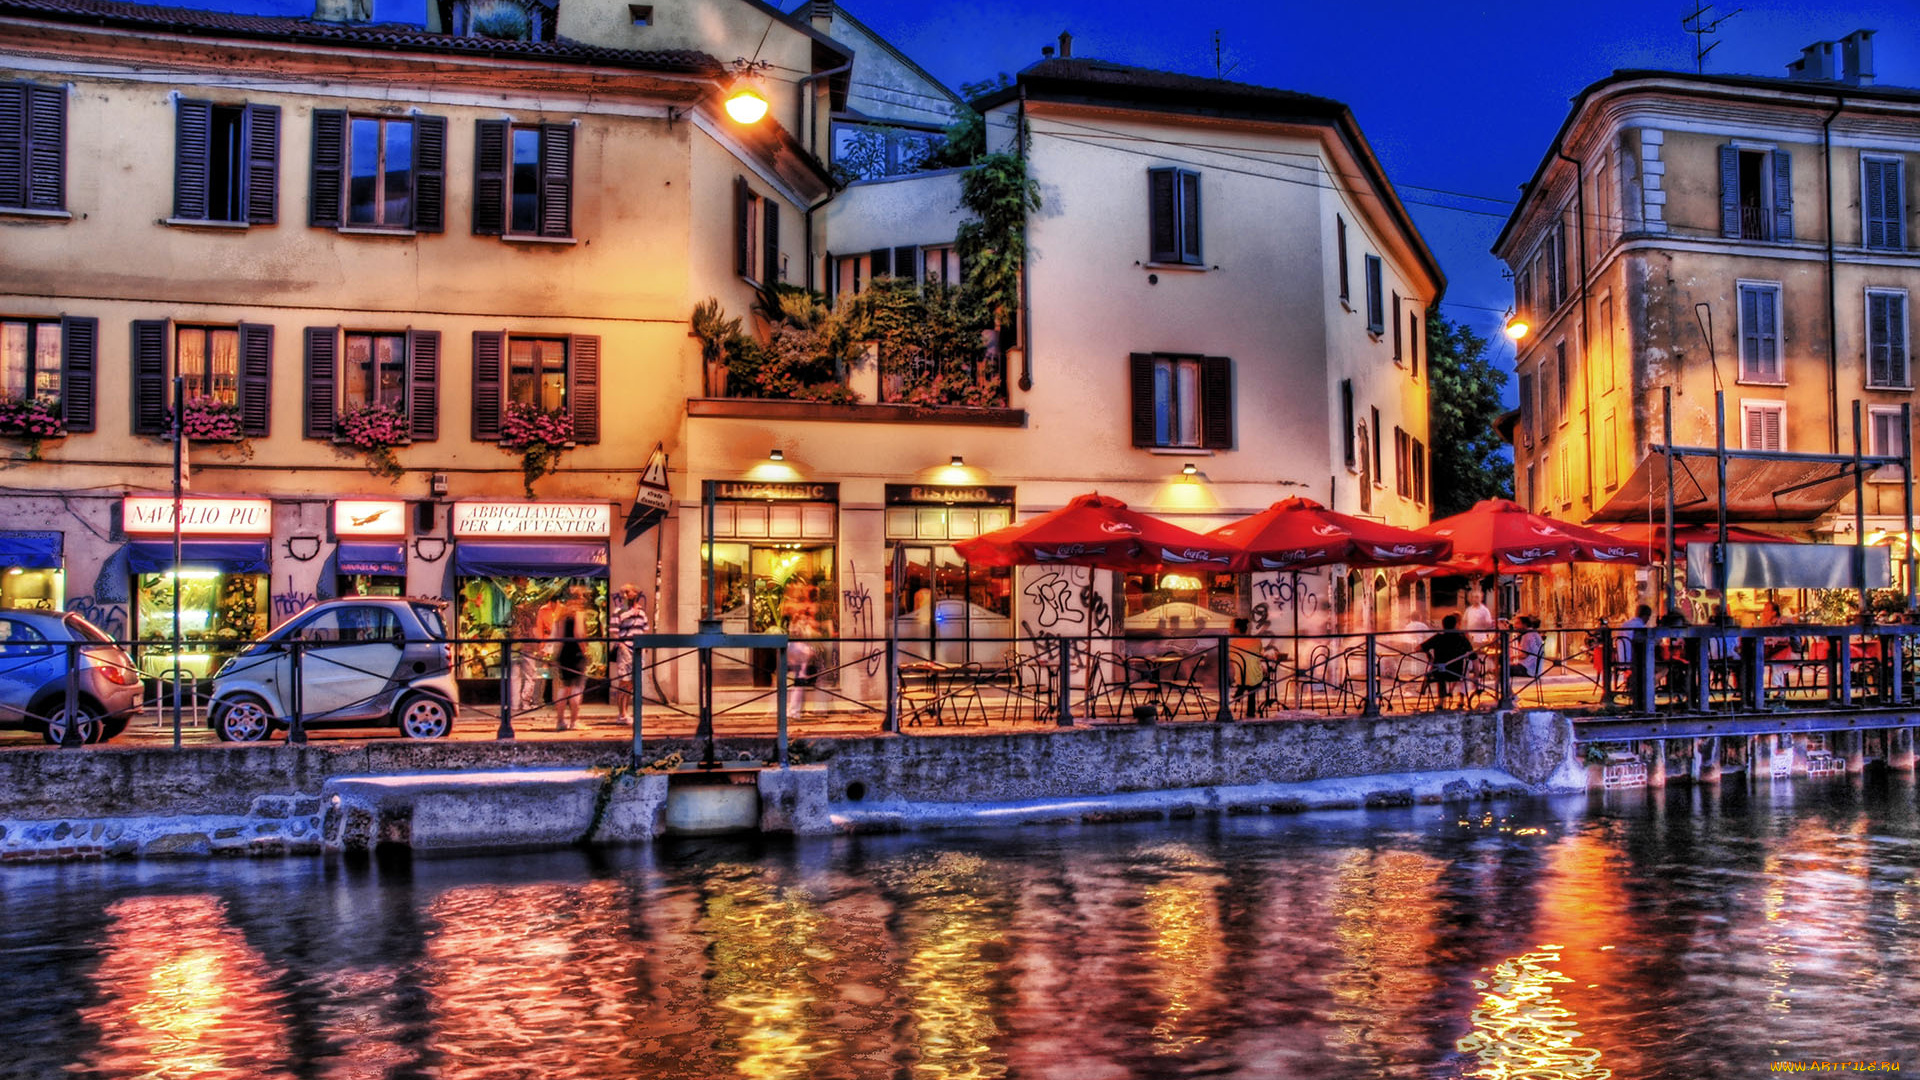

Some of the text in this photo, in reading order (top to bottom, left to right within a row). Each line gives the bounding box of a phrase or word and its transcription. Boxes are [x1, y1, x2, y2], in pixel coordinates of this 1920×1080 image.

[131, 505, 220, 524] NAVIGLIO
[467, 506, 597, 519] ABBIGLIAMENTO
[459, 519, 488, 532] PER
